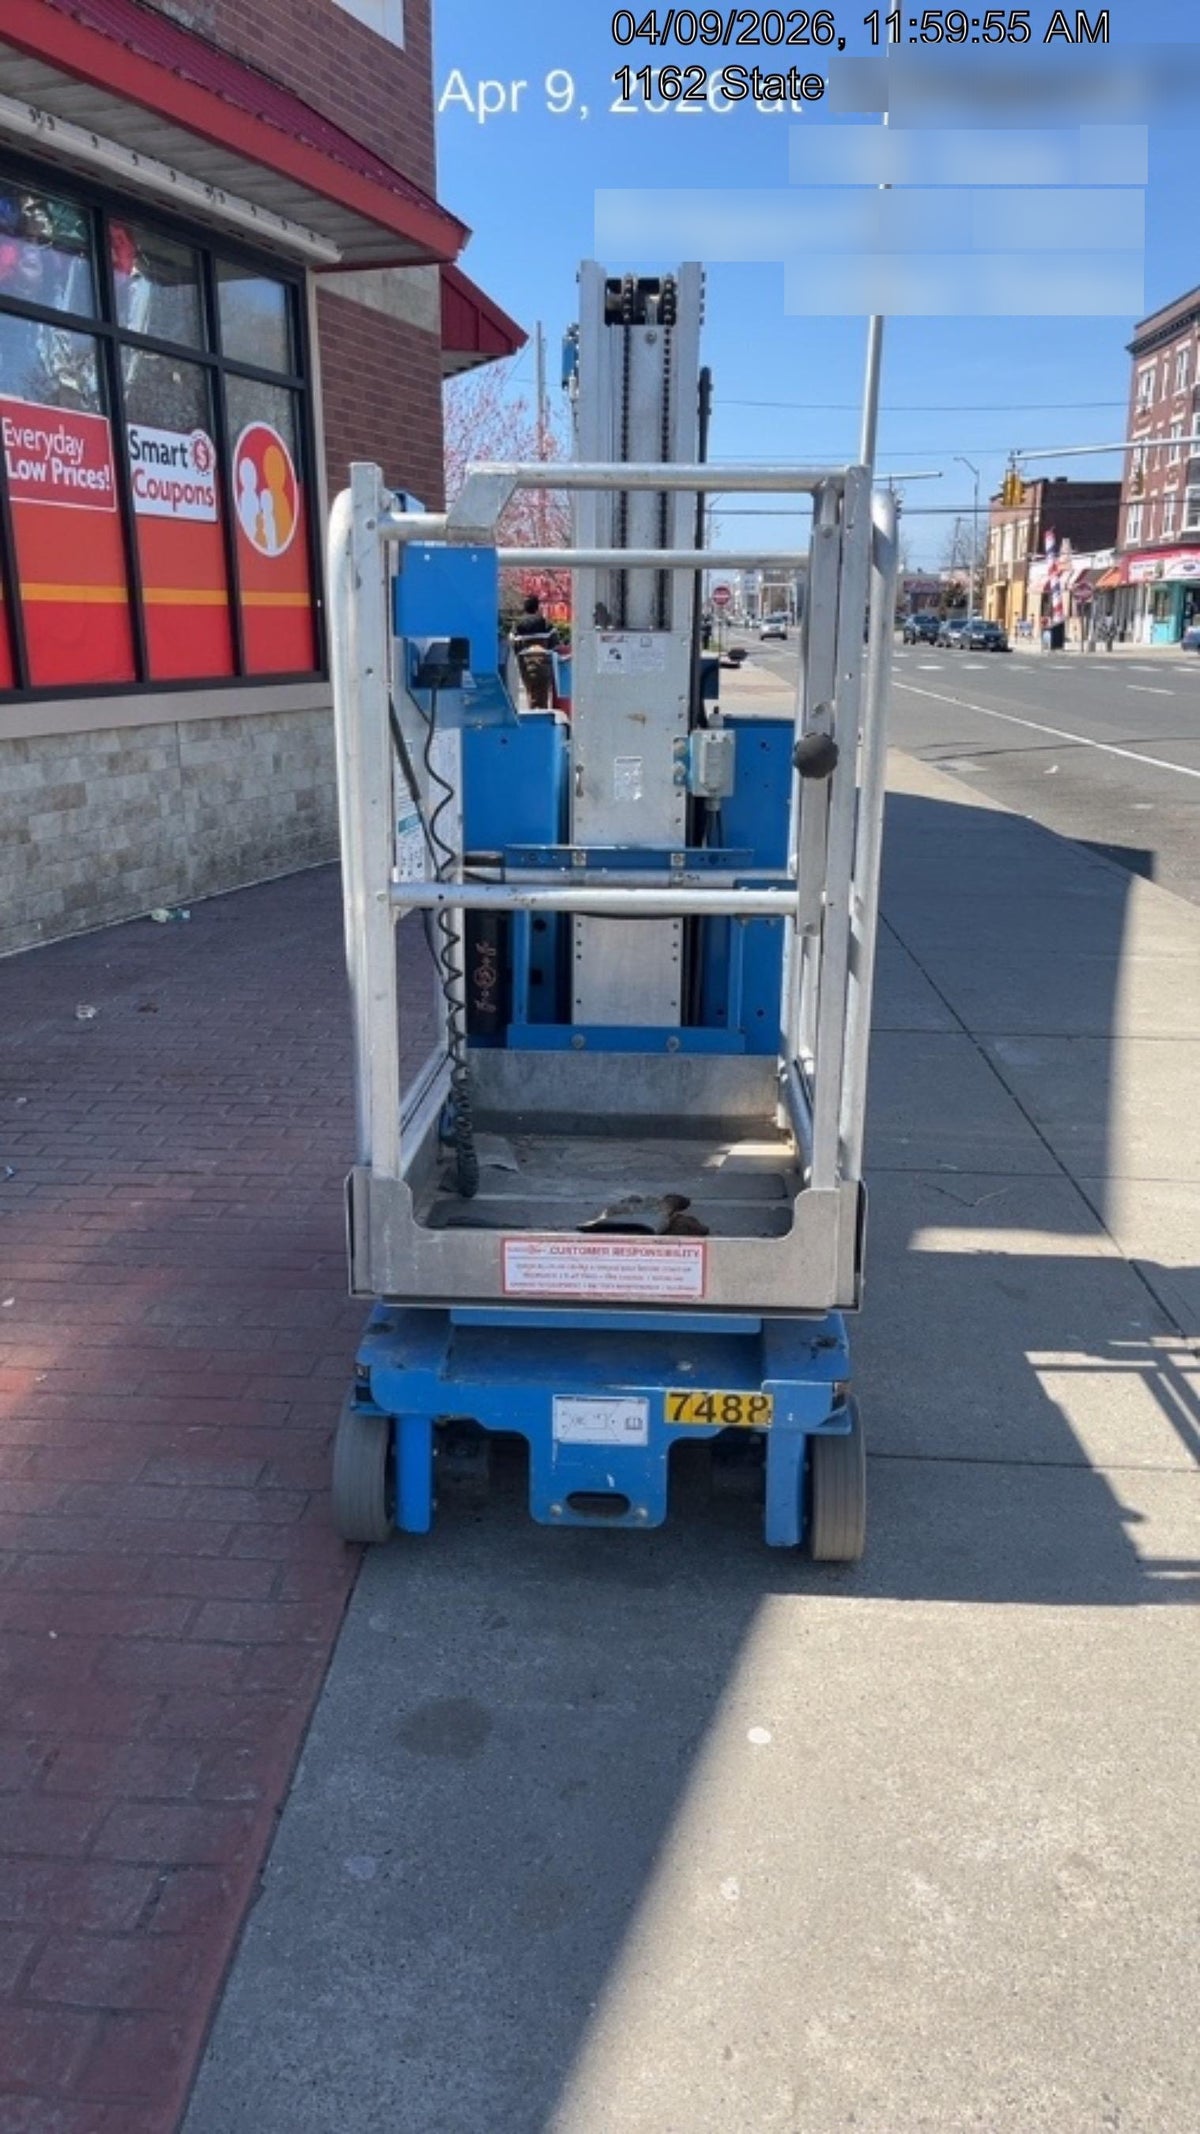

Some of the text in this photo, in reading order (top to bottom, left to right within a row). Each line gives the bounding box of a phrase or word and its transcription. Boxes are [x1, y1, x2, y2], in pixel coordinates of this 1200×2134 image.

[1, 416, 84, 465] Everyday
[129, 429, 188, 468] Smart
[4, 449, 110, 490] Low Prices!
[133, 468, 214, 512] Coupons
